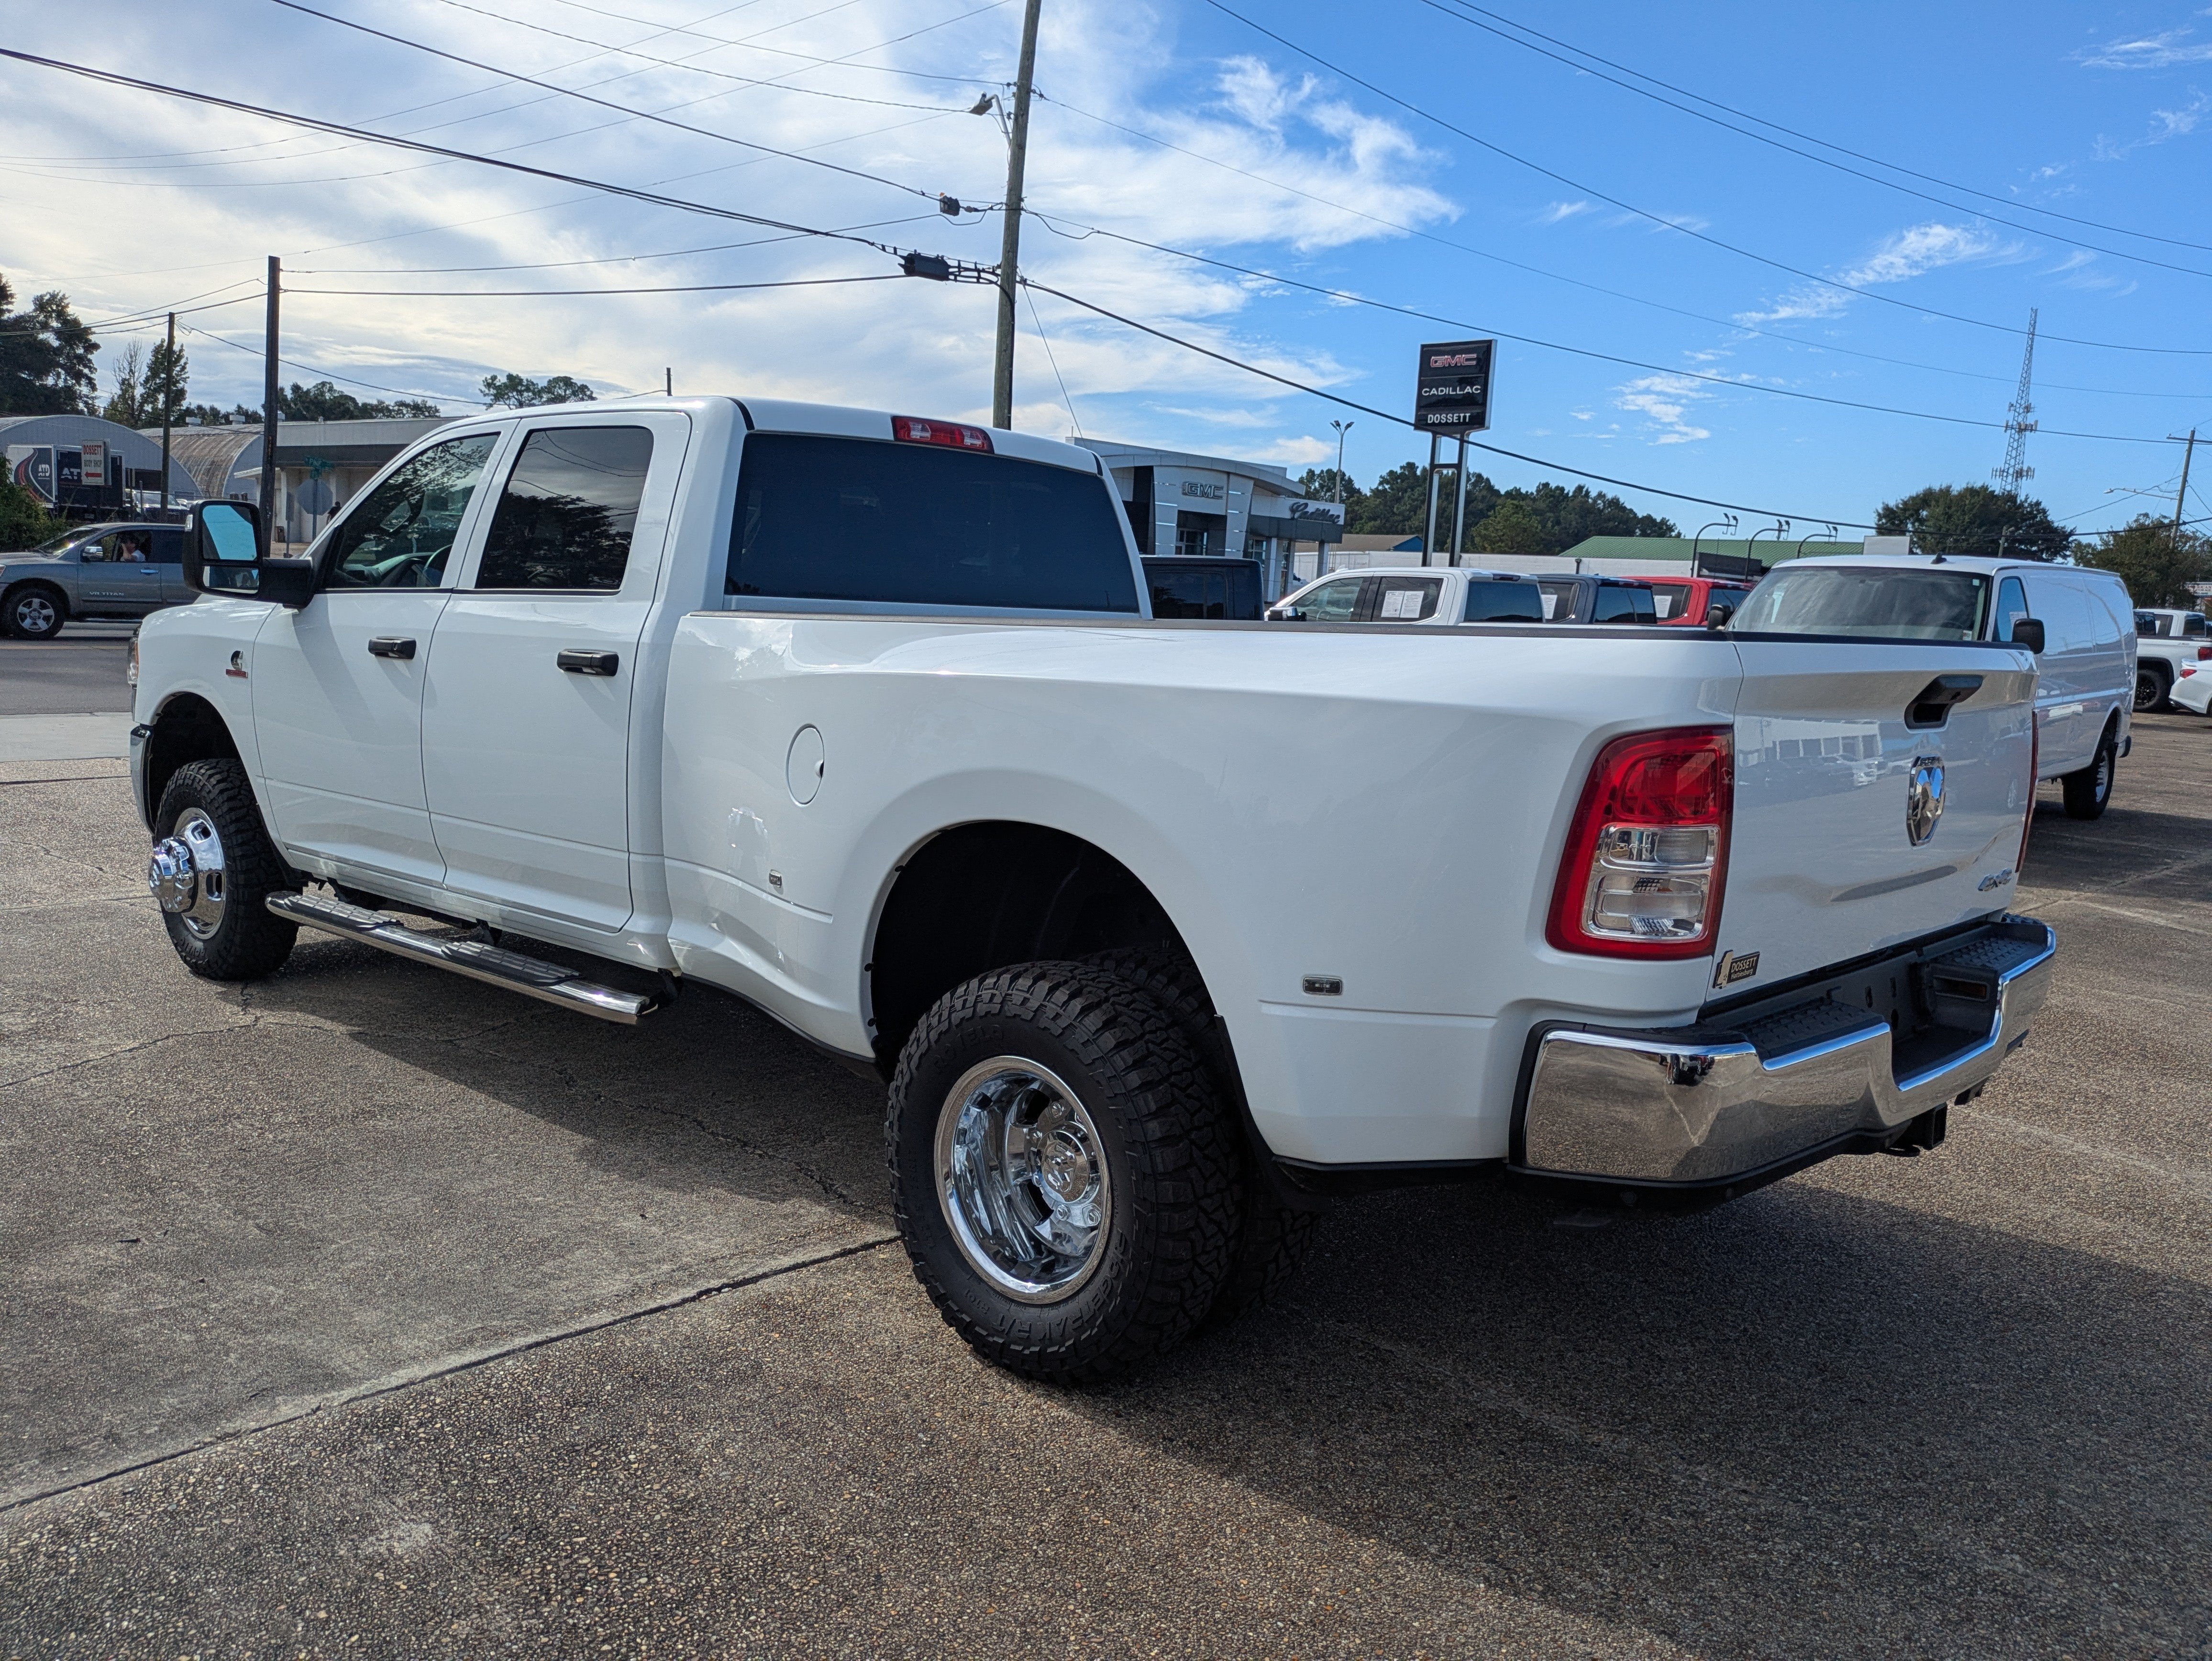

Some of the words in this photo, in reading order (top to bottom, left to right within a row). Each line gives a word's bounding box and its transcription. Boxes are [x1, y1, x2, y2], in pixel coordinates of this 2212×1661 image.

[1430, 354, 1477, 367] GMC
[1422, 385, 1481, 396] CADILLAC
[1427, 413, 1471, 423] DOSSETT
[83, 444, 102, 455] DOSSETT
[38, 464, 50, 476] ATD
[61, 467, 81, 480] AT
[1183, 482, 1224, 500] GMC
[1289, 502, 1341, 524] Cadillac
[1730, 957, 1757, 973] DOSSETT
[1730, 968, 1753, 980] Hattiesburg
